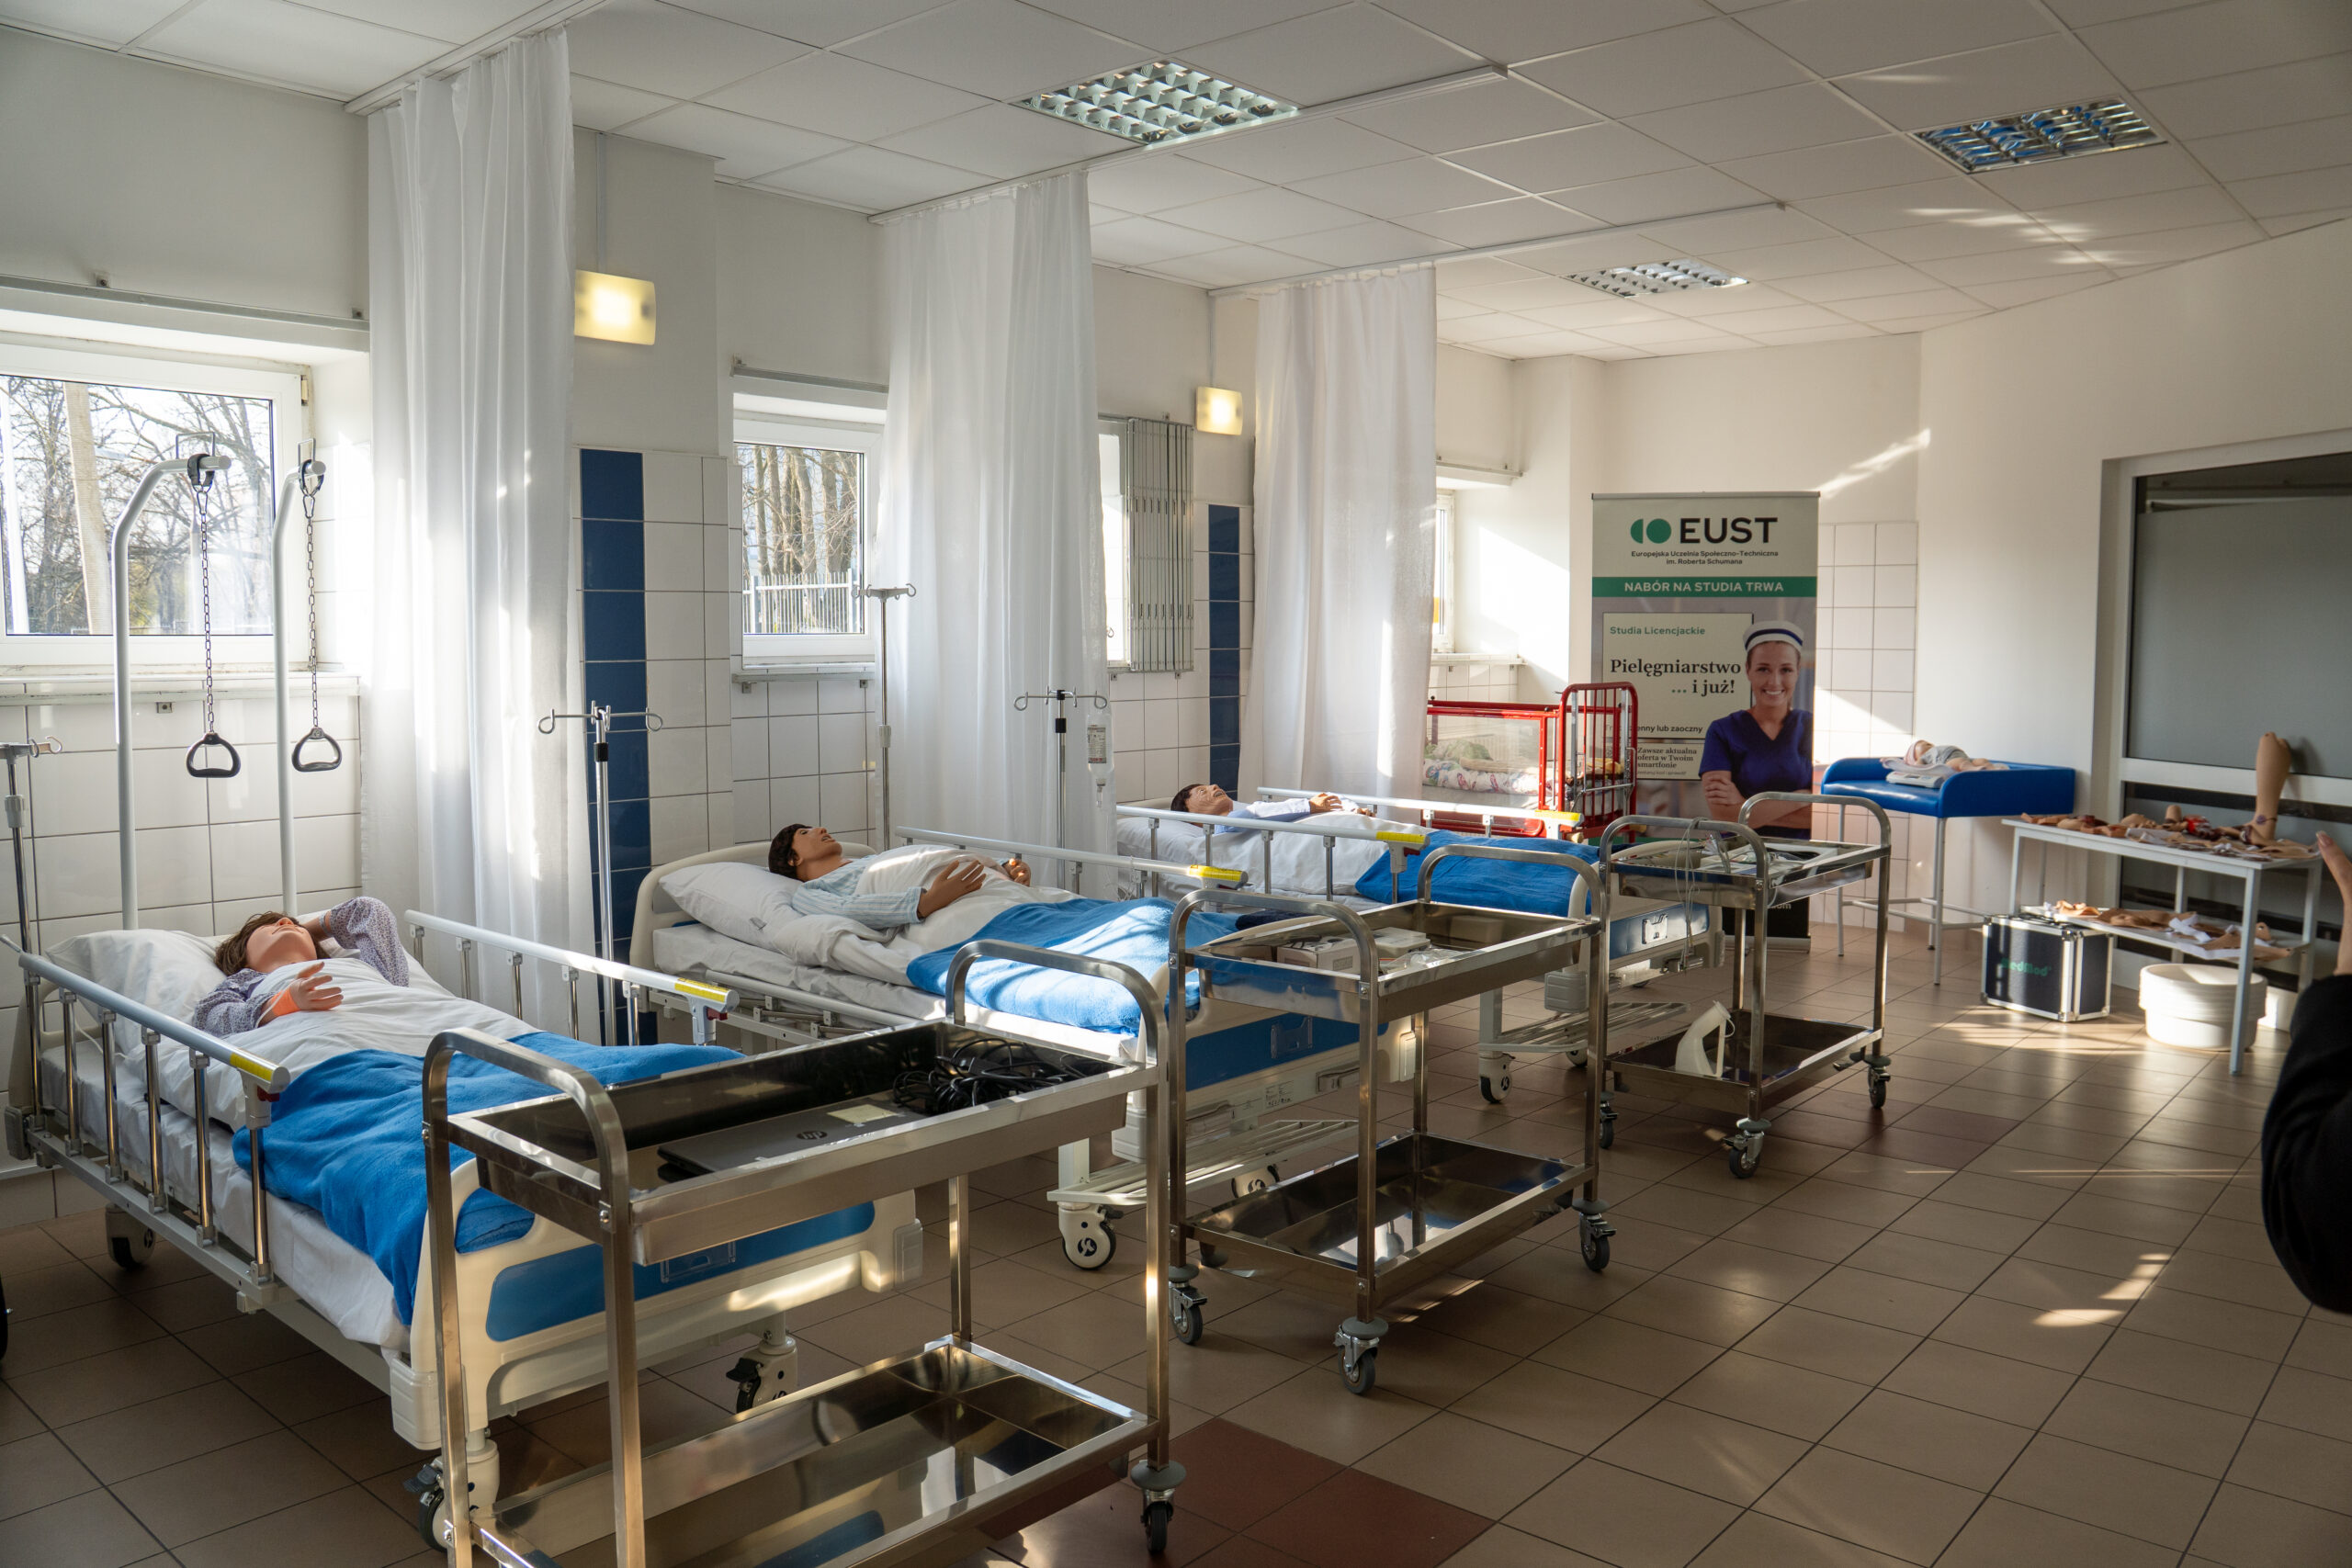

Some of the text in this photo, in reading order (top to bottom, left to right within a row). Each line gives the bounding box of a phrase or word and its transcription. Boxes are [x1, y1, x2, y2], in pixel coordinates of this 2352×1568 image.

[1679, 516, 1779, 544] EUST
[1624, 580, 1784, 592] NABÓR NA STUDIA TRWA
[1610, 626, 1706, 637] Studia Licencjackie
[1610, 658, 1741, 677] Pielęgniarstwo
[1692, 679, 1698, 694] i
[1701, 679, 1736, 697] już!
[1657, 724, 1669, 732] lub
[1670, 726, 1703, 734] zaoczny
[1665, 747, 1697, 755] aktualna
